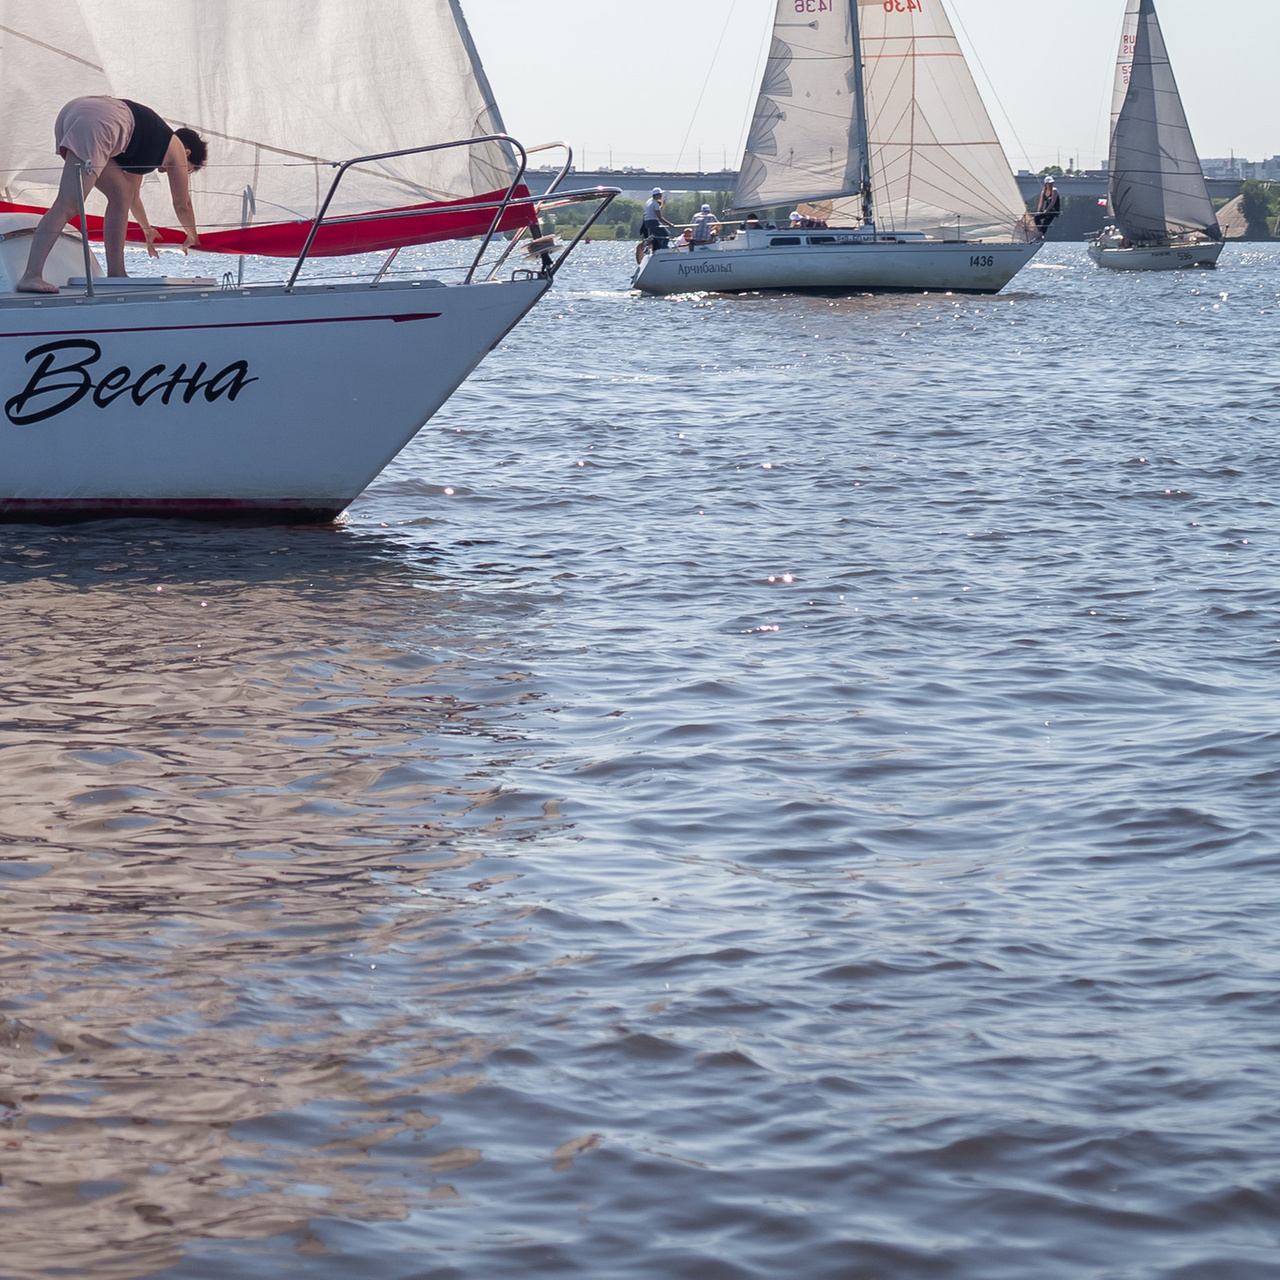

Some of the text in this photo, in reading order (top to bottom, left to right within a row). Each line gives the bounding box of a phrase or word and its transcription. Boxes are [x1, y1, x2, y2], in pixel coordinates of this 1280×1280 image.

[1123, 34, 1136, 44] RU
[970, 255, 994, 267] 1436
[677, 261, 733, 277] Арчибальд
[4, 338, 260, 426] Весна
